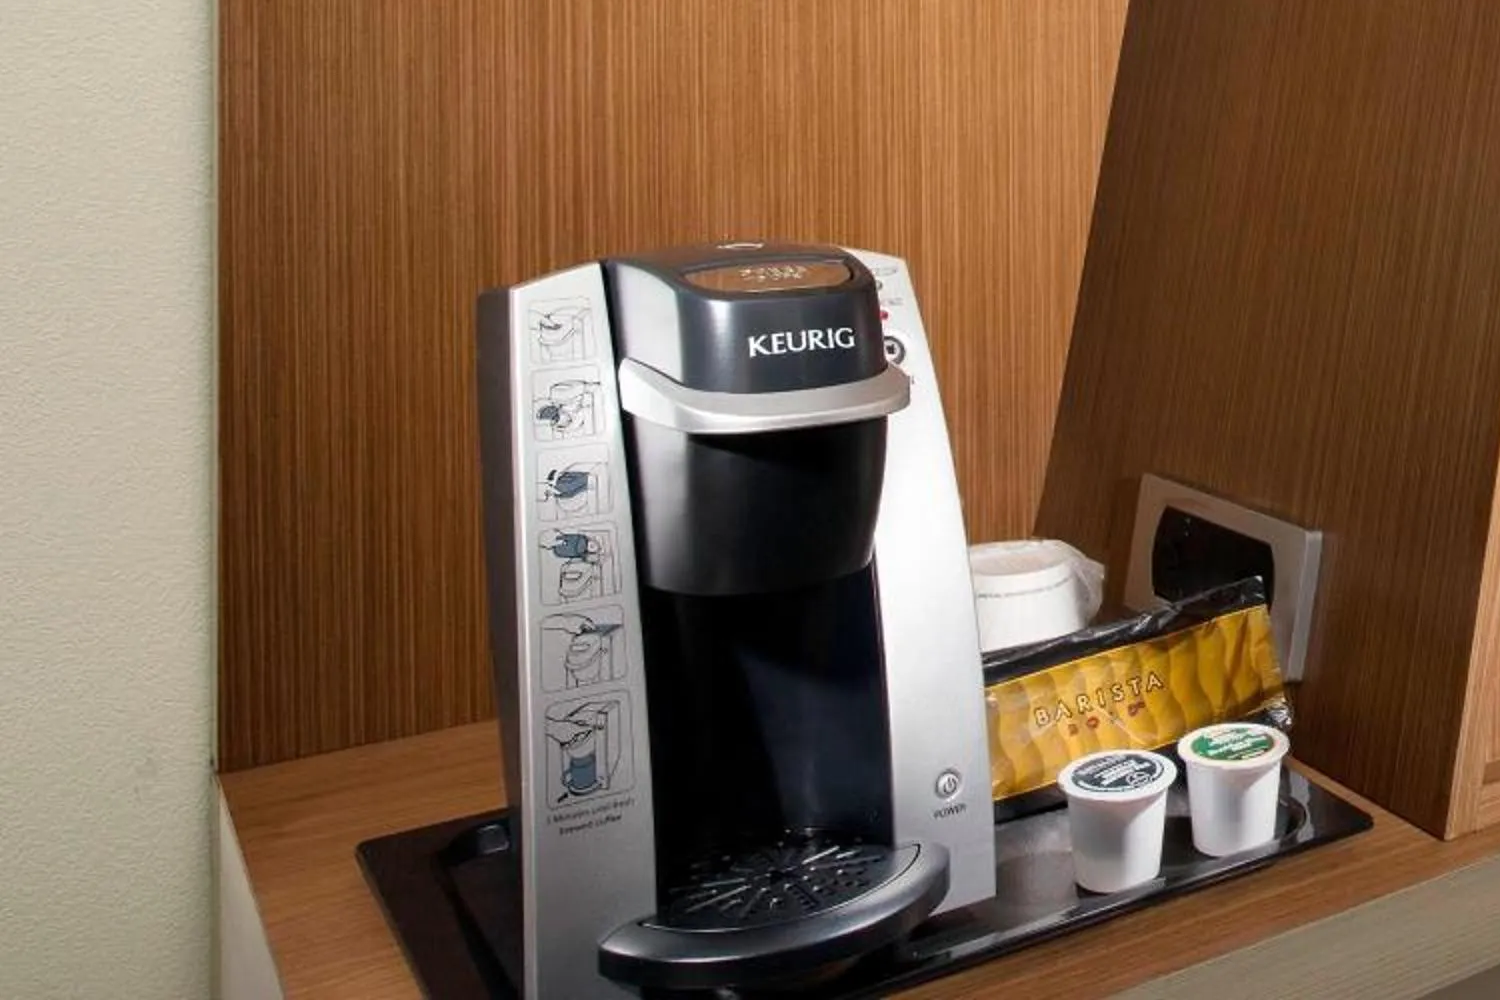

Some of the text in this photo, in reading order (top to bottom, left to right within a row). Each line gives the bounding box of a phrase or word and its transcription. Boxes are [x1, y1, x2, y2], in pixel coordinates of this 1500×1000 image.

[747, 327, 856, 358] KEURIG
[1033, 670, 1165, 727] BARISTA
[933, 803, 967, 819] POWER
